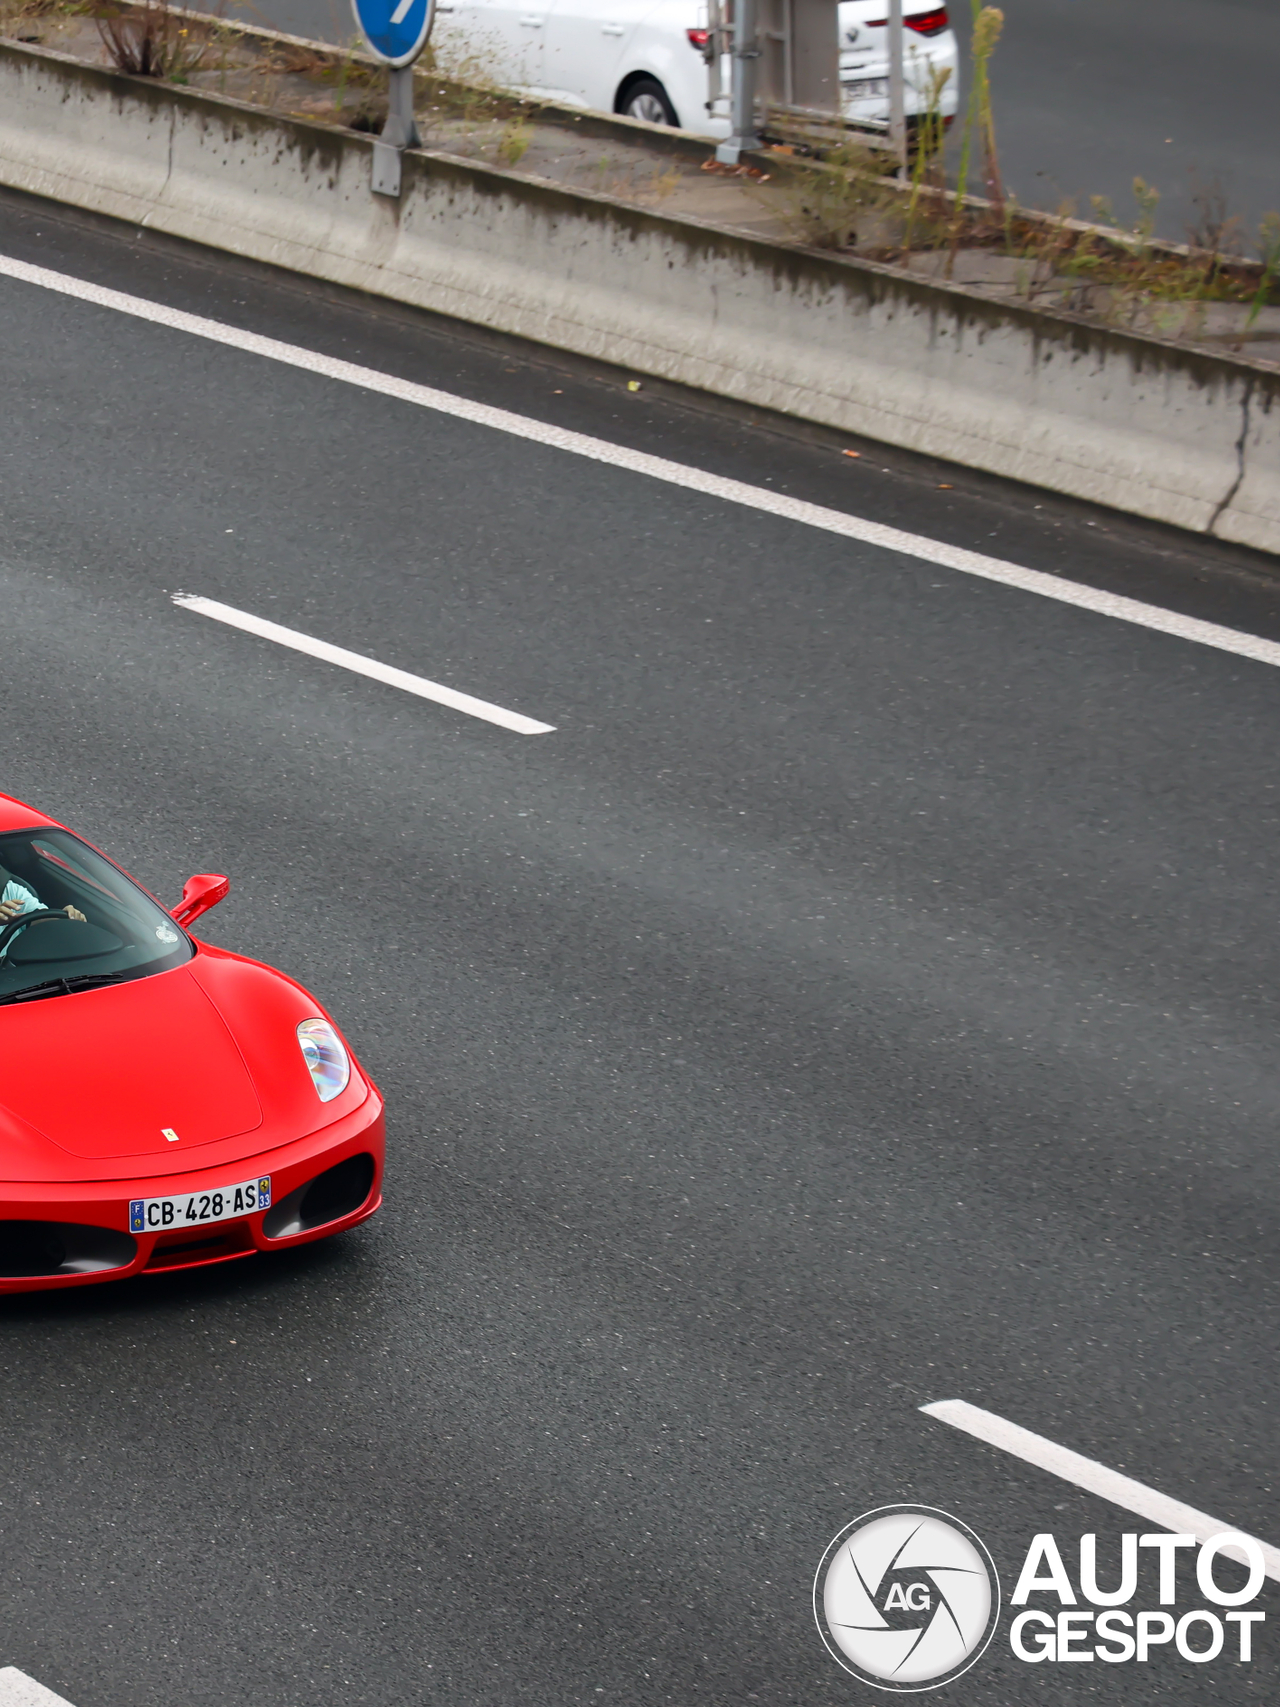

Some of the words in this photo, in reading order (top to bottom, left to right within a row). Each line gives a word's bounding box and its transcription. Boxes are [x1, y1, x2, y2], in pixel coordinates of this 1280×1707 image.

[147, 1184, 256, 1226] CB-428-AS
[259, 1193, 270, 1207] 33
[134, 1204, 140, 1213] F
